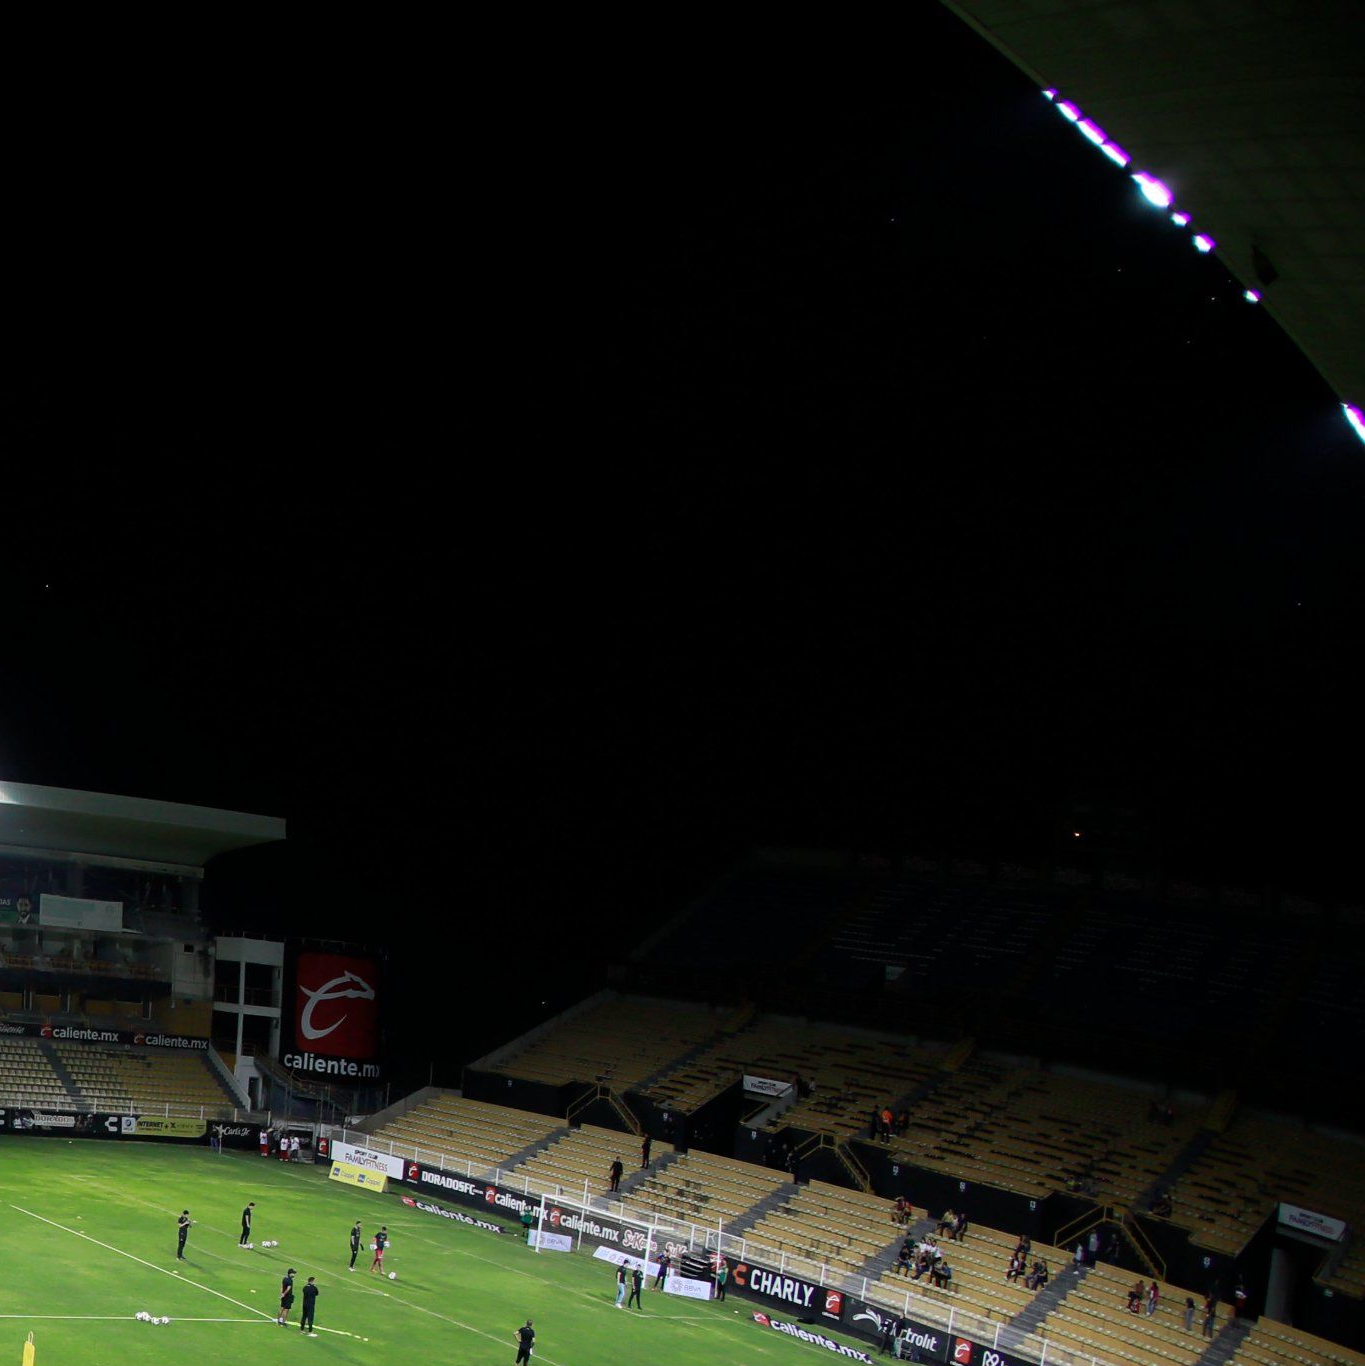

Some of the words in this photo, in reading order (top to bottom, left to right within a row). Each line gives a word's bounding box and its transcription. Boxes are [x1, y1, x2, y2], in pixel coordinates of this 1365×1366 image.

[53, 1026, 119, 1042] caliente.mx
[146, 1034, 208, 1050] caliente.mx
[283, 1053, 382, 1078] caliente.mx
[415, 1201, 502, 1234] caliente.mx
[750, 1269, 816, 1307] CHARLY
[770, 1319, 874, 1365] caliente.mx
